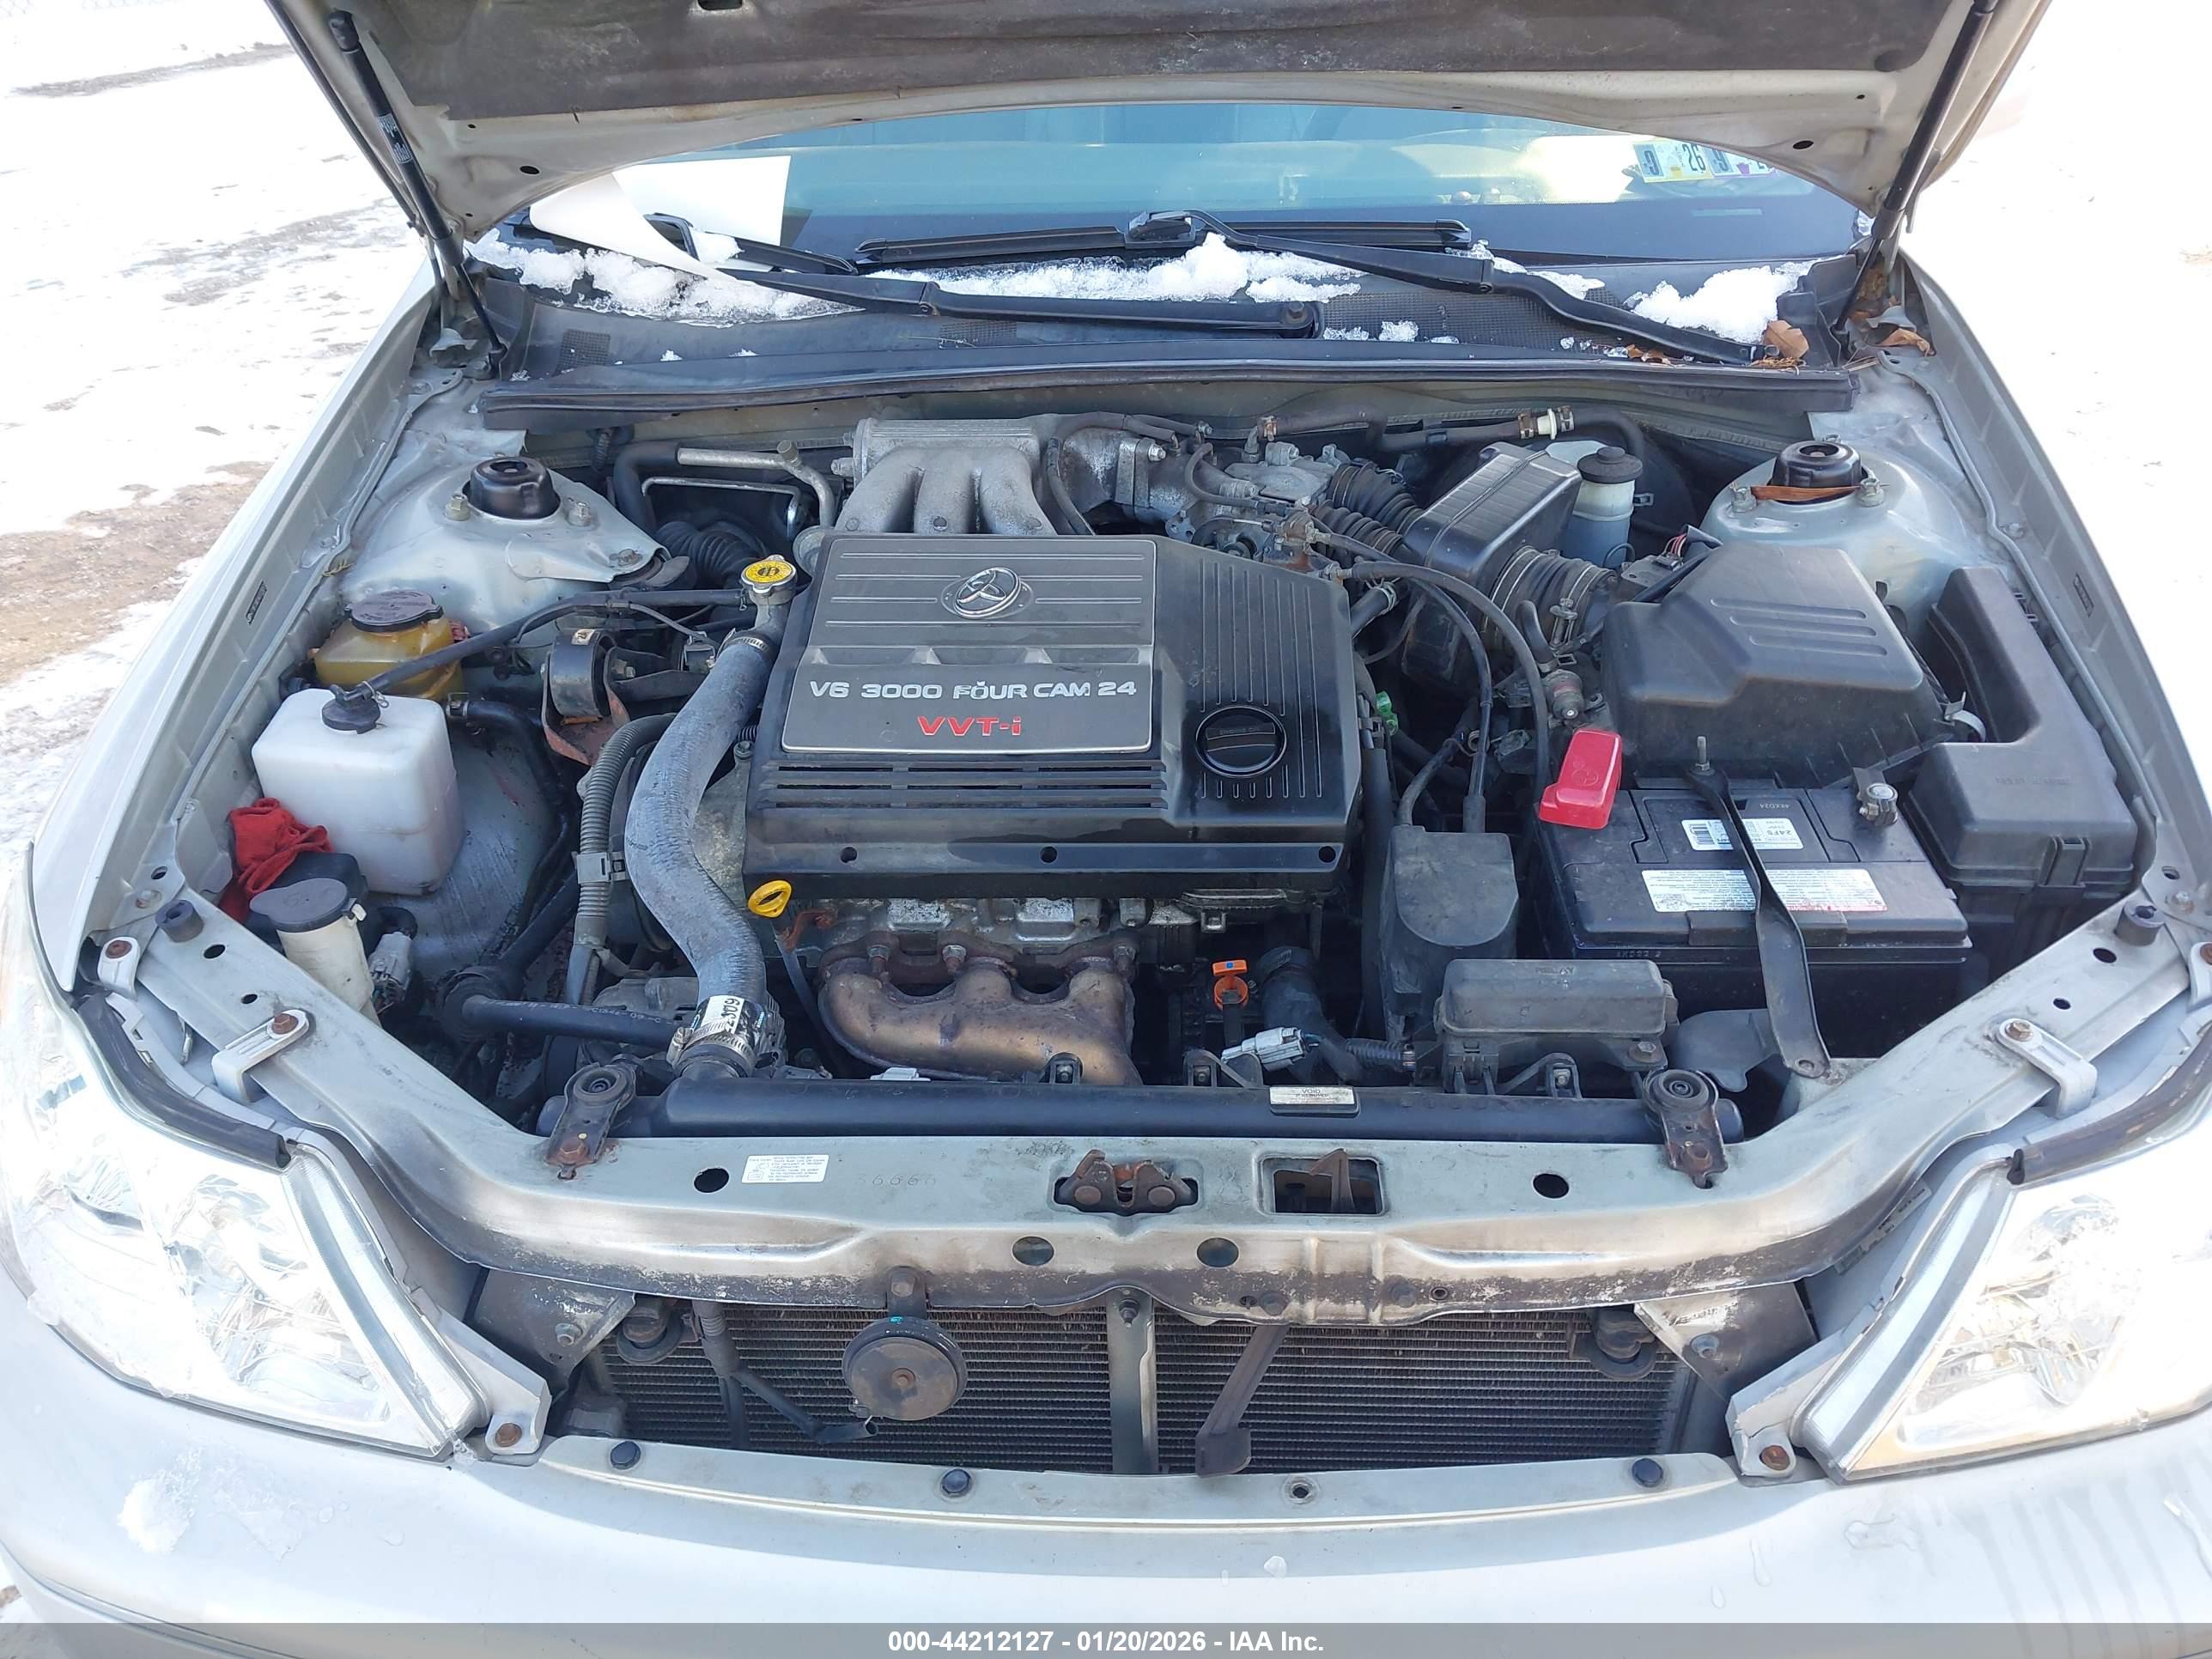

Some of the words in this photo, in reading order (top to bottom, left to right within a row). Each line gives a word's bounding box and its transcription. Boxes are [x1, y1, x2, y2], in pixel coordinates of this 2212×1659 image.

[1682, 143, 1706, 172] 26
[810, 681, 850, 698] V6
[860, 684, 943, 699] 3000
[953, 682, 1028, 700] FOUR
[1033, 682, 1091, 698] CAM
[1097, 681, 1137, 696] 24
[917, 715, 1022, 737] VVT-i
